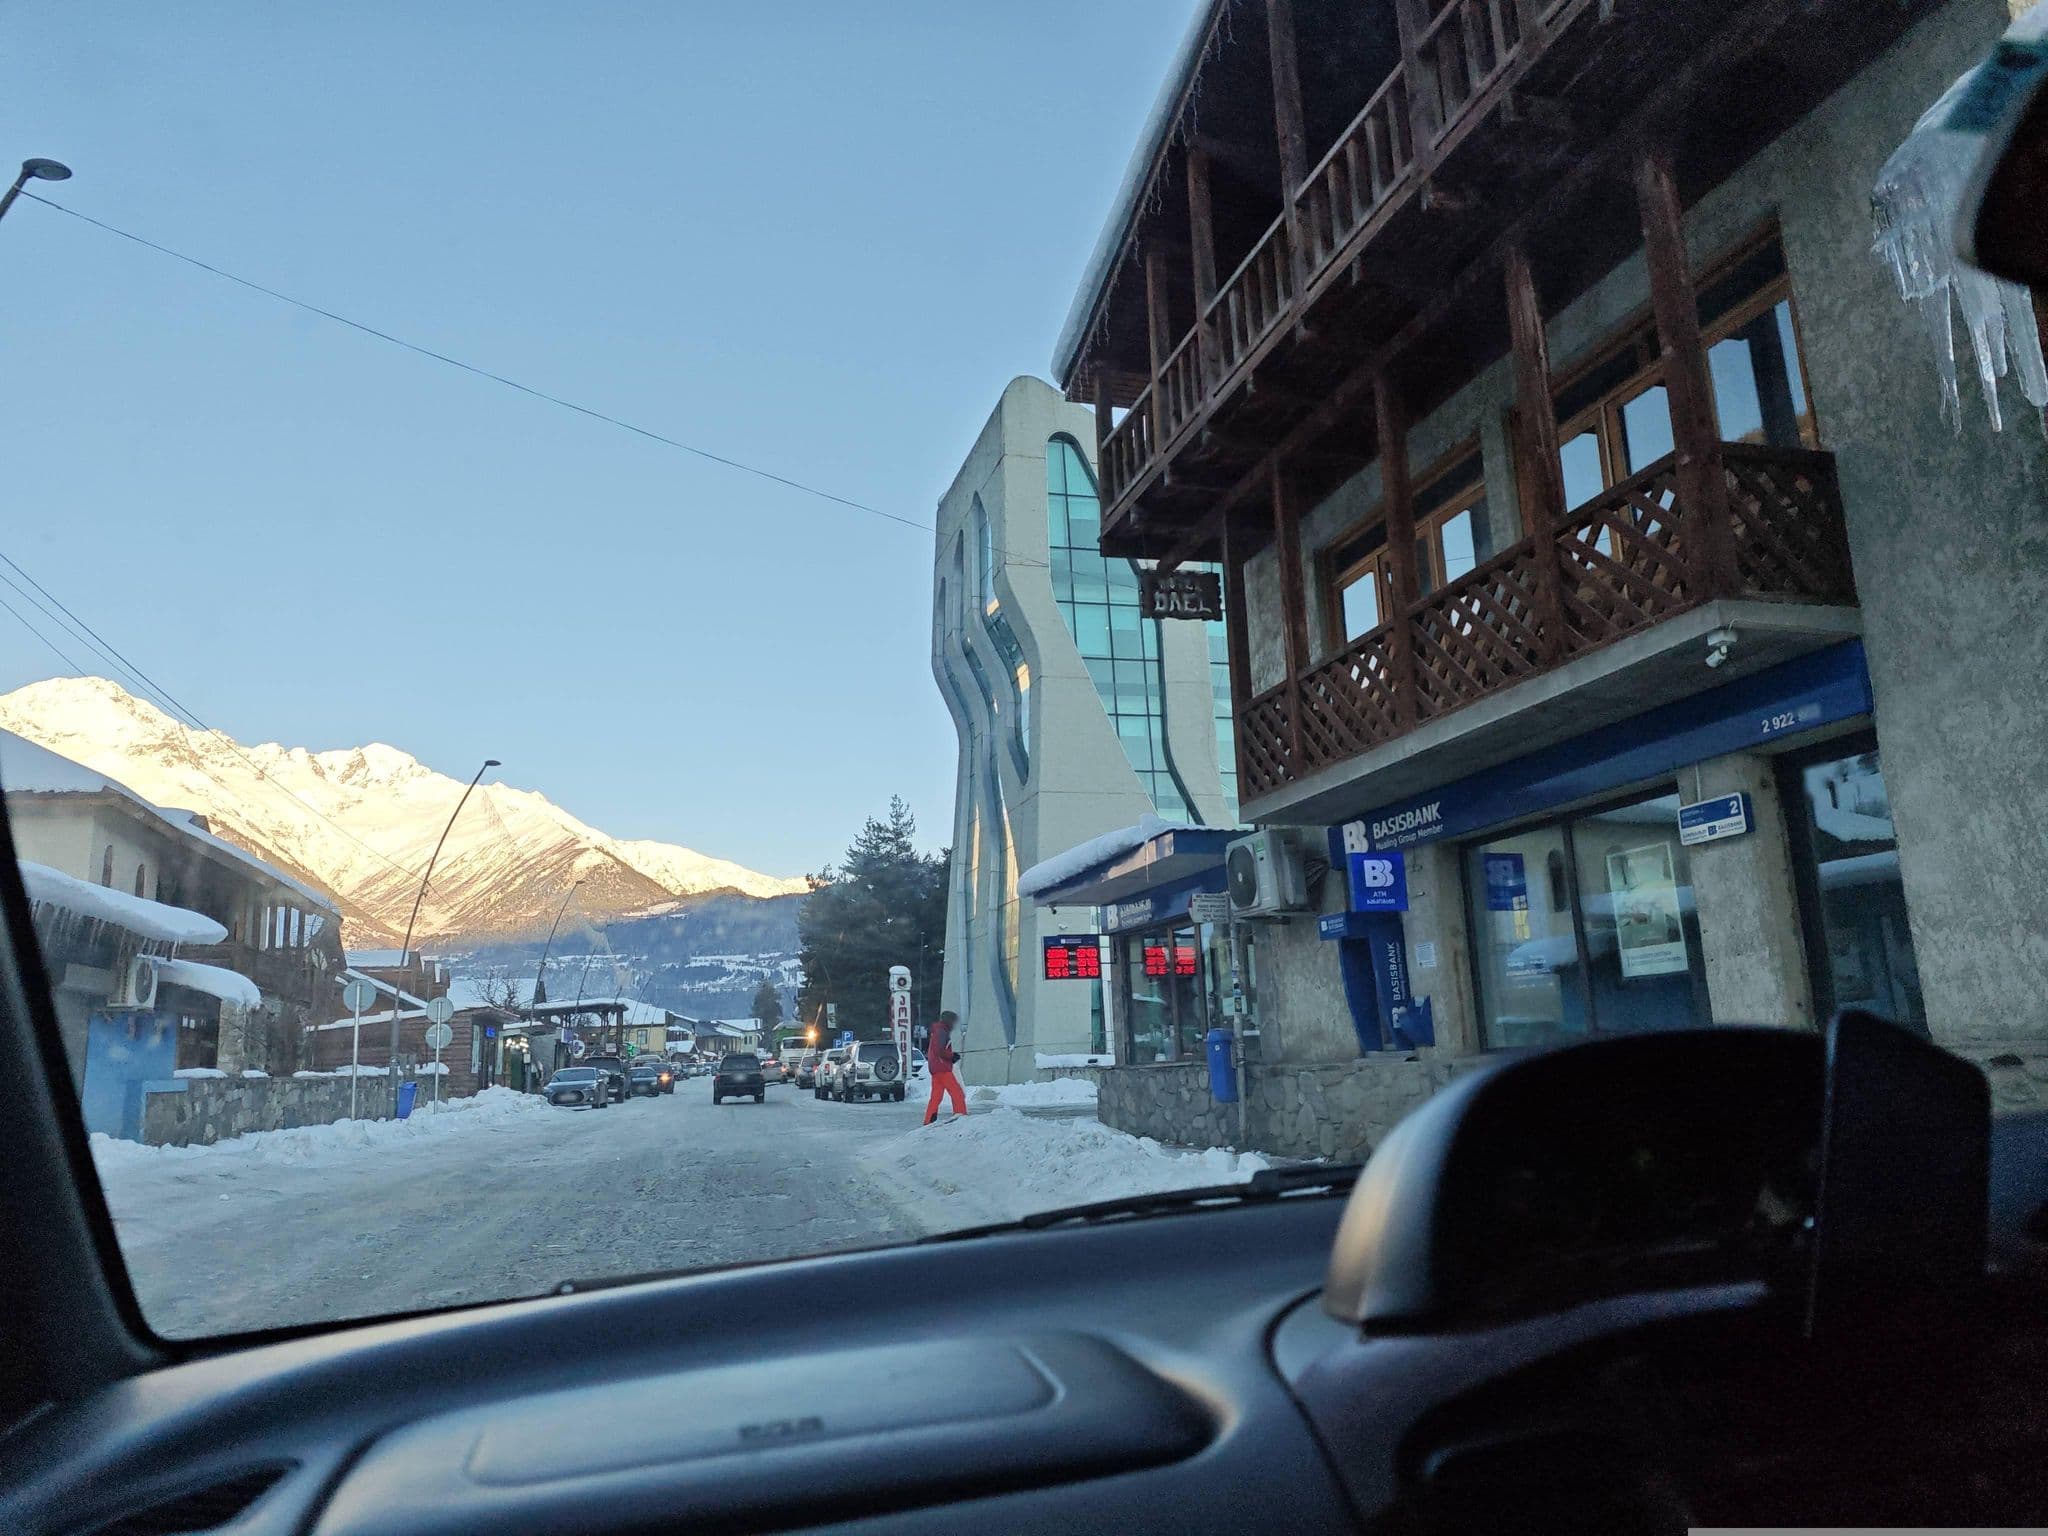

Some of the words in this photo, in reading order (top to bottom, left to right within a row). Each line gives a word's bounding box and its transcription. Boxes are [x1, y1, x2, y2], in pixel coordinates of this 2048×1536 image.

[1761, 719, 1771, 734] 2
[1772, 712, 1796, 730] 922
[1729, 800, 1739, 815] 2
[1372, 801, 1443, 840] BASISBANK
[1398, 832, 1418, 845] Group
[1417, 823, 1444, 840] Member
[1372, 890, 1388, 898] ATM
[1386, 941, 1401, 1001] BASISBANK
